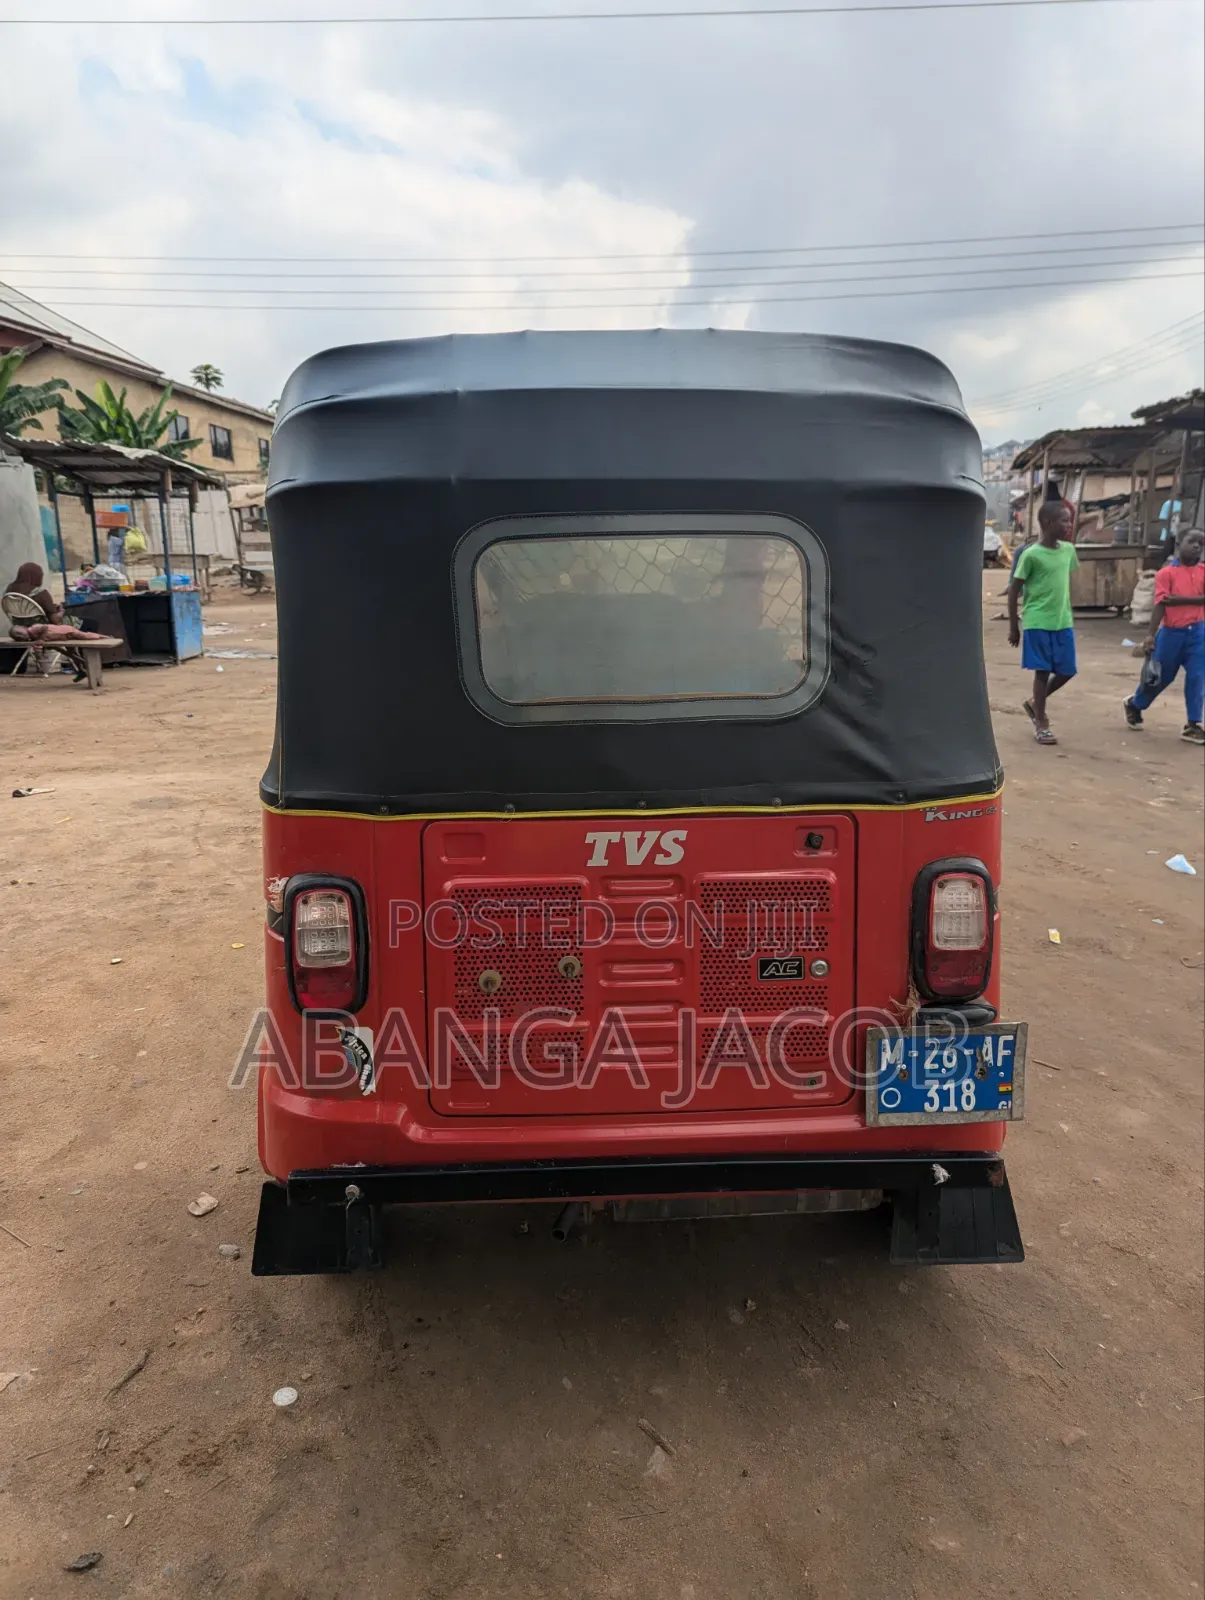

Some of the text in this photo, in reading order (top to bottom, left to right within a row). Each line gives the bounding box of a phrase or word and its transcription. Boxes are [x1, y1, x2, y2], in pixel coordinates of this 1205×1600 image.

[584, 830, 688, 867] TVS
[762, 961, 800, 976] AC
[924, 1078, 976, 1113] 318
